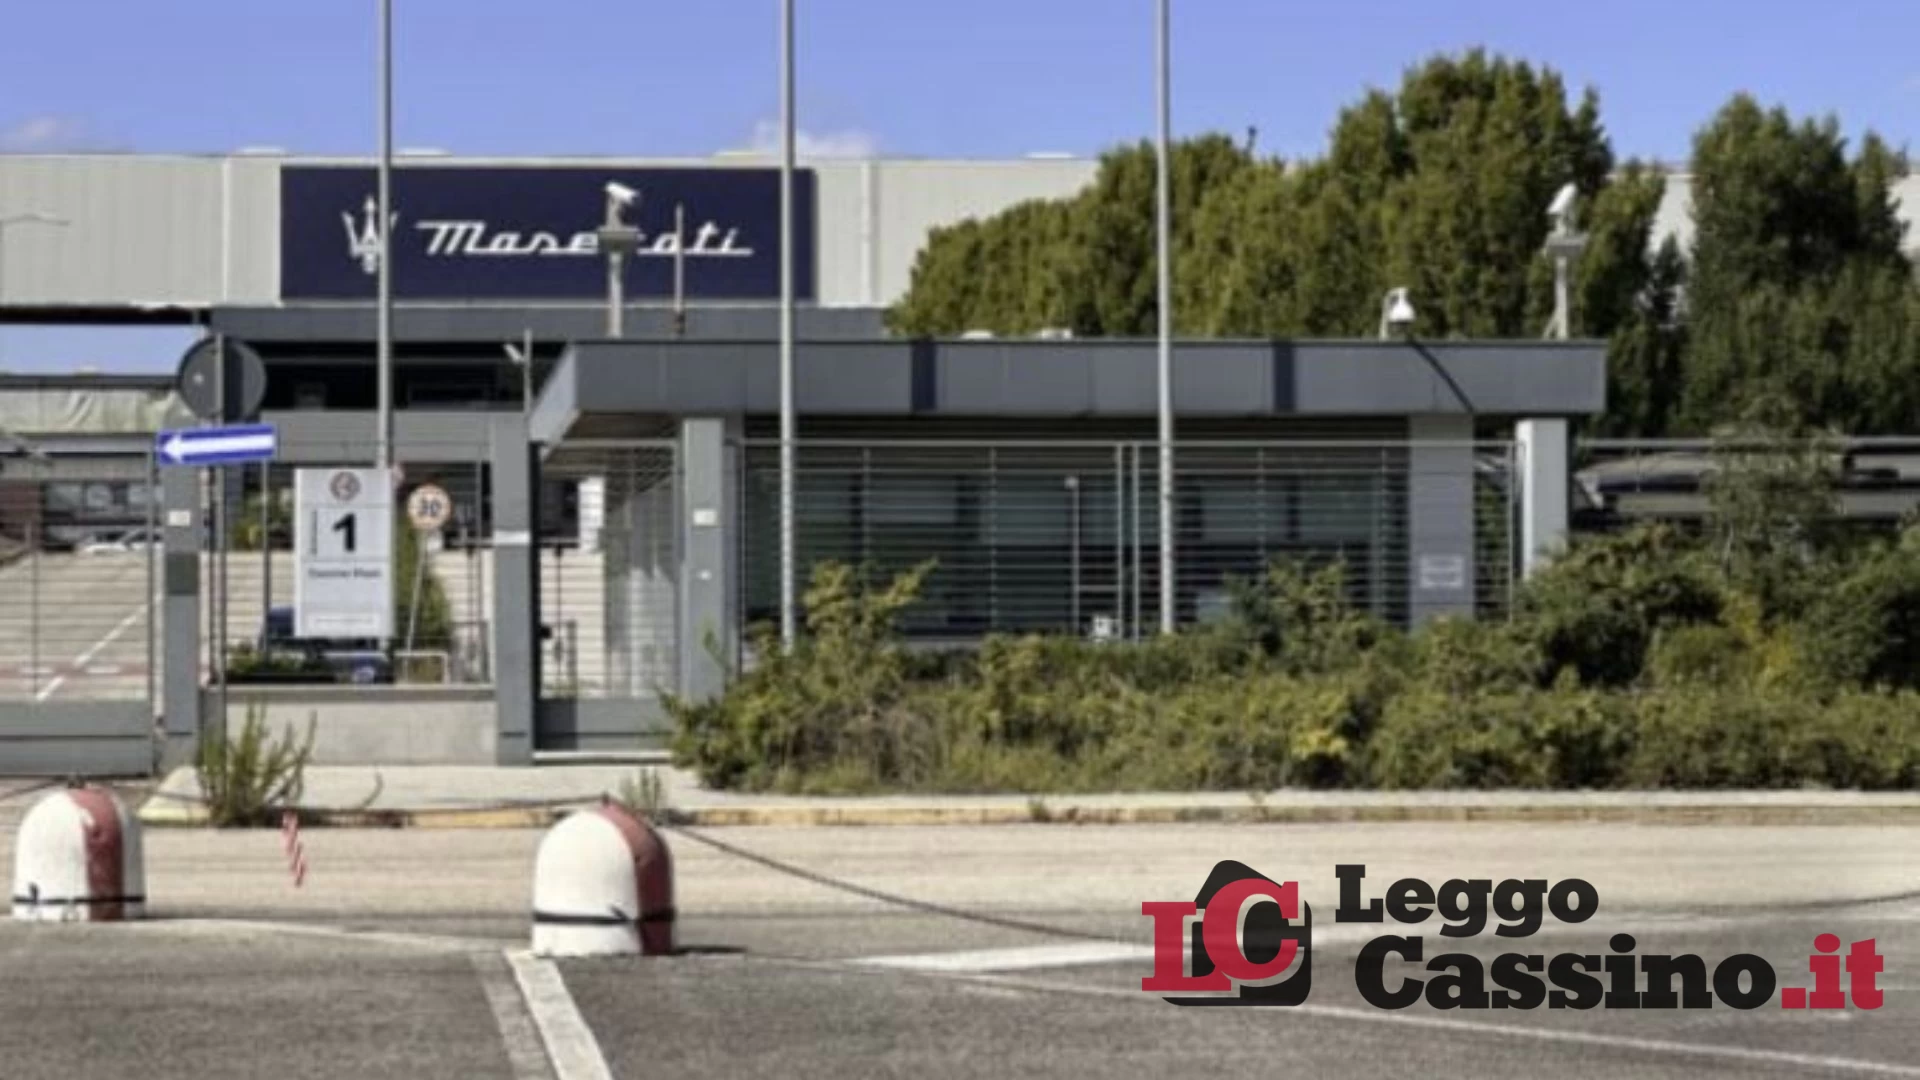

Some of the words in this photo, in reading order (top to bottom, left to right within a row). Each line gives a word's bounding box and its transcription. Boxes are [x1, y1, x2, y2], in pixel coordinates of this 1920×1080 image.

[416, 221, 754, 256] Maseati
[418, 497, 443, 519] 30
[333, 513, 356, 552] 1
